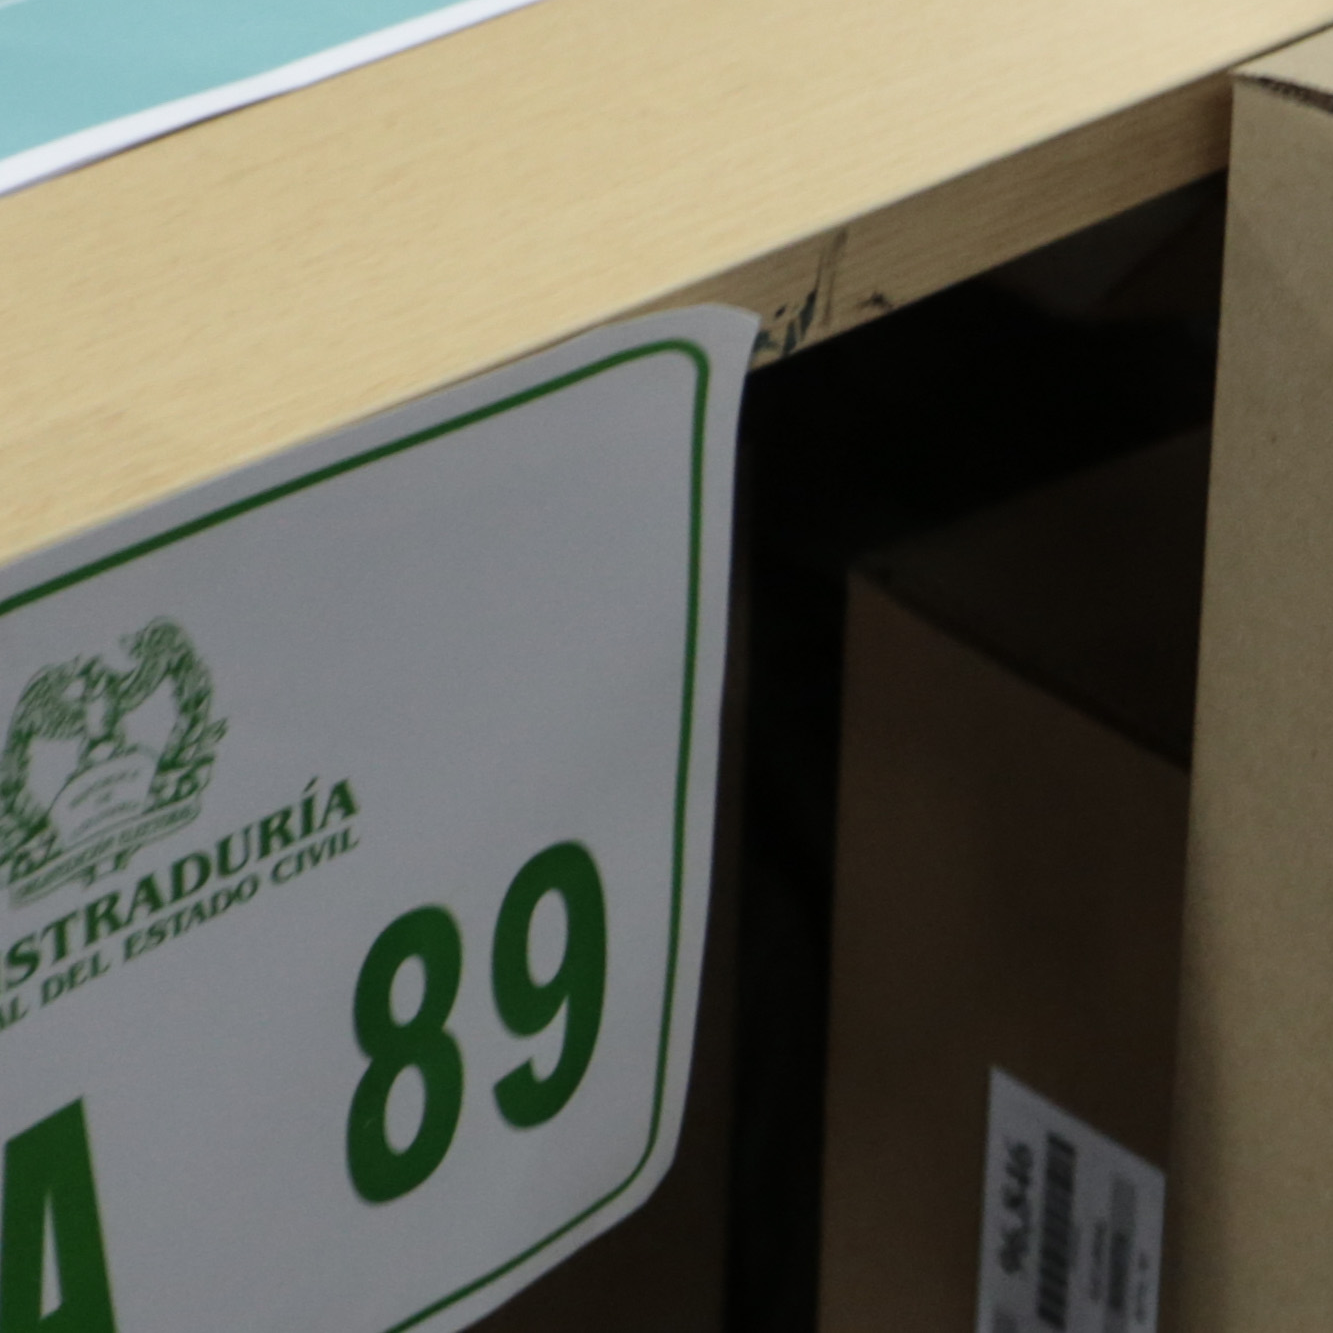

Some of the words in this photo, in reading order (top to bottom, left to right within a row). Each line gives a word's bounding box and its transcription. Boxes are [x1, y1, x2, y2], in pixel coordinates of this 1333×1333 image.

[3, 775, 361, 993] STRADURÍA
[41, 949, 113, 1008] DEL
[123, 874, 261, 963] ESTADO
[270, 824, 361, 886] CIVIL
[346, 838, 607, 1208] 89
